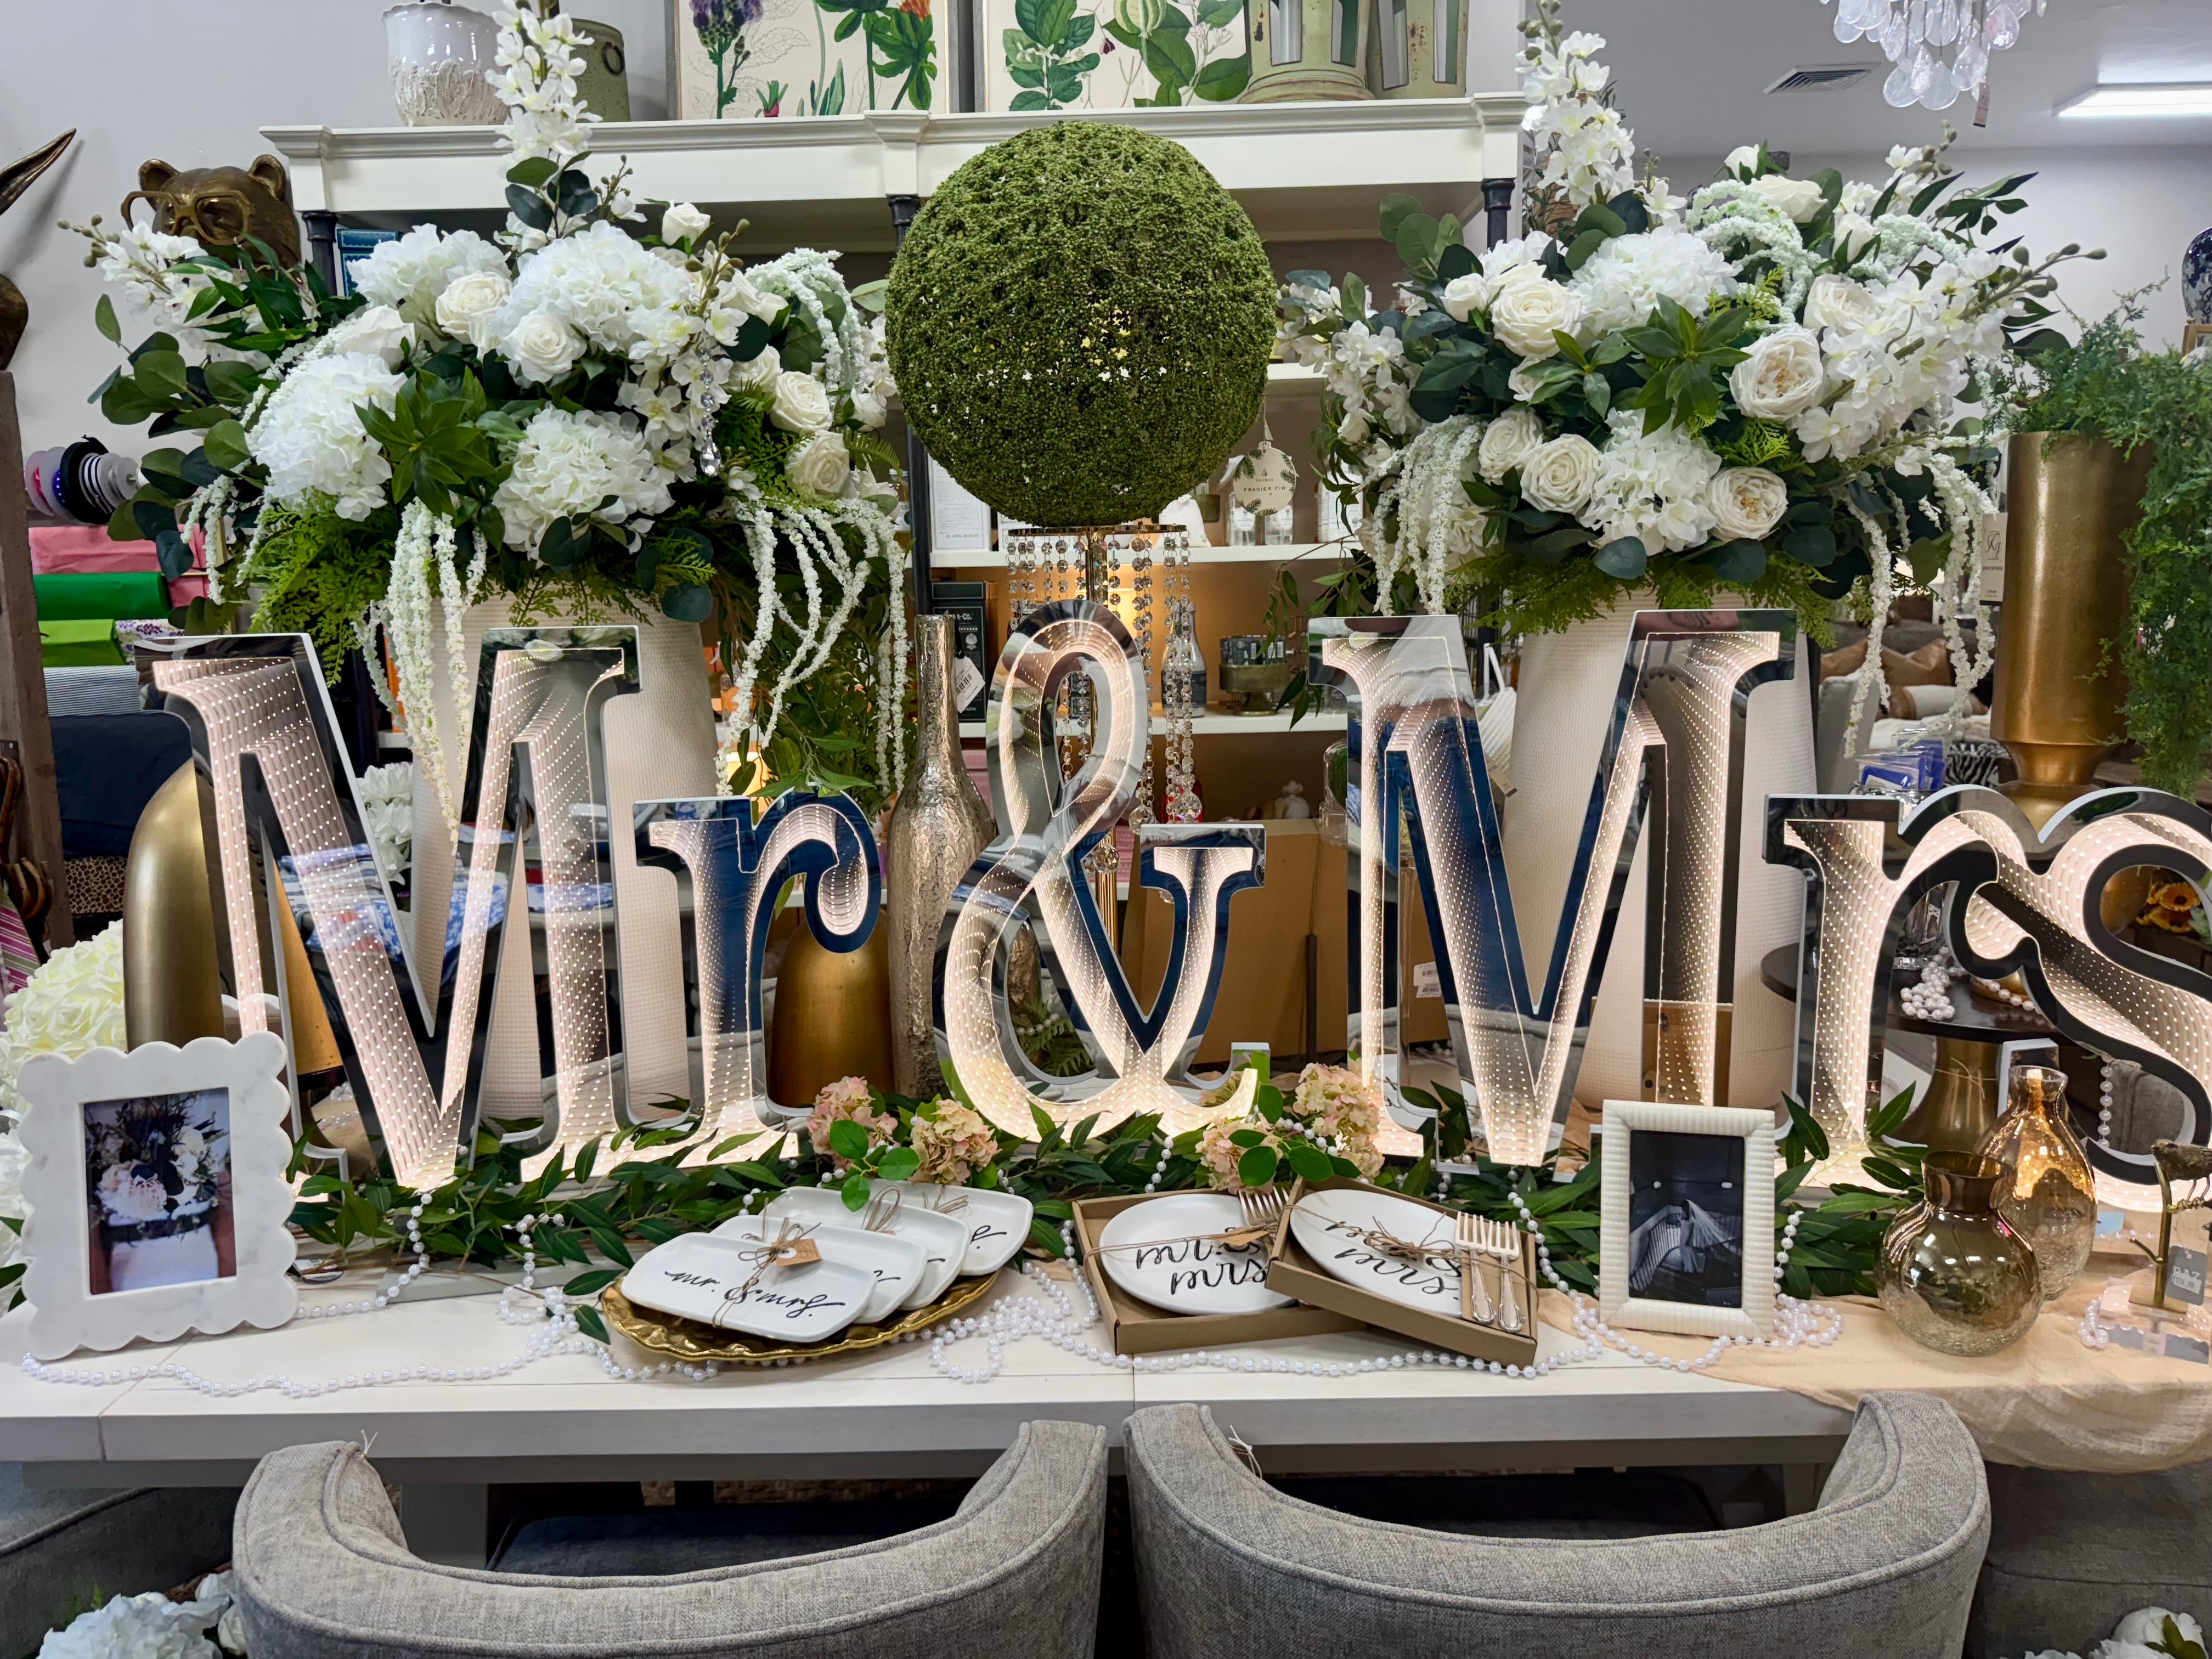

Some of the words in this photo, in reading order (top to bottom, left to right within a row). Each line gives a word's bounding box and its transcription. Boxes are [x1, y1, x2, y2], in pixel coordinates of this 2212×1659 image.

[136, 625, 880, 1190] Mr
[932, 599, 1270, 1143] &
[1307, 608, 2212, 1212] Mrs
[1136, 1237, 1222, 1269] mr.
[664, 1271, 721, 1293] mr.
